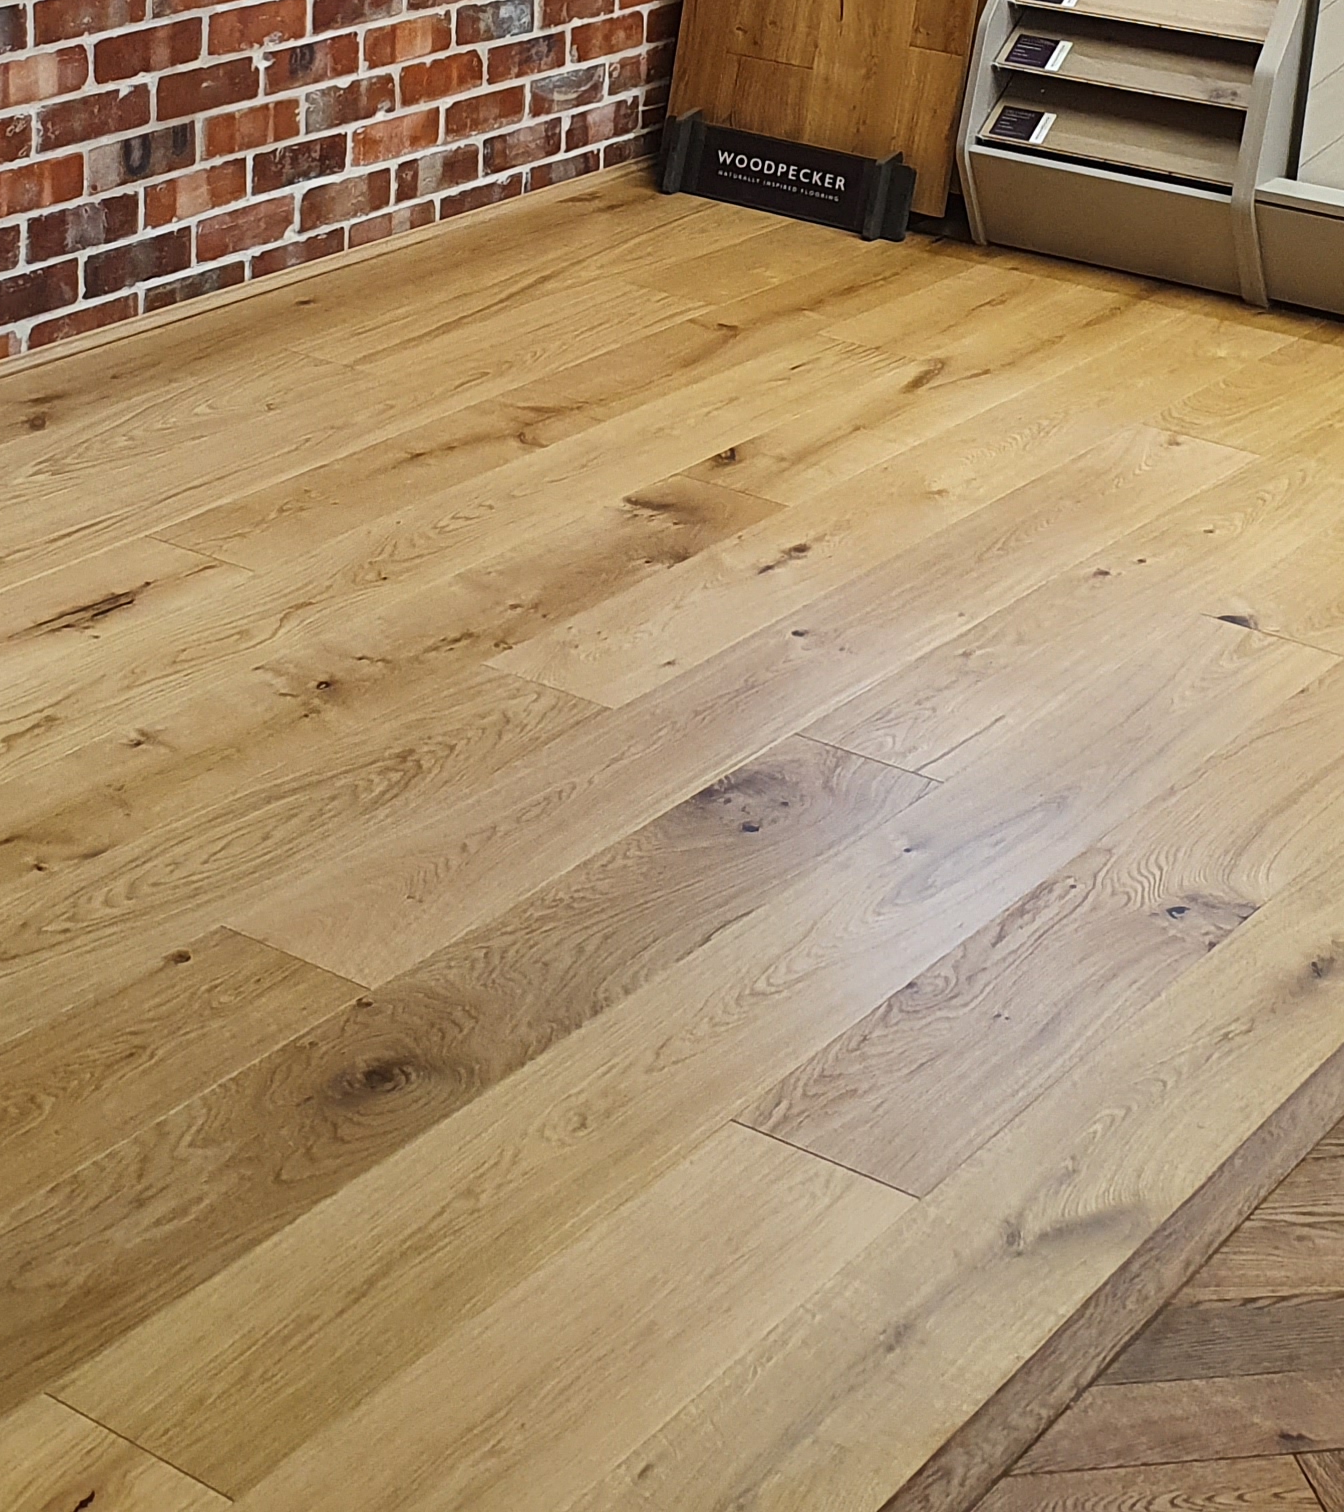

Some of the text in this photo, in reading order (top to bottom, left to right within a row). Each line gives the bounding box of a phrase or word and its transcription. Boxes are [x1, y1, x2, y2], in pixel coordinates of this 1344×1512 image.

[718, 149, 845, 192] WOODPECKER
[718, 170, 839, 202] NATURALLY INSPIRED FLOORING
